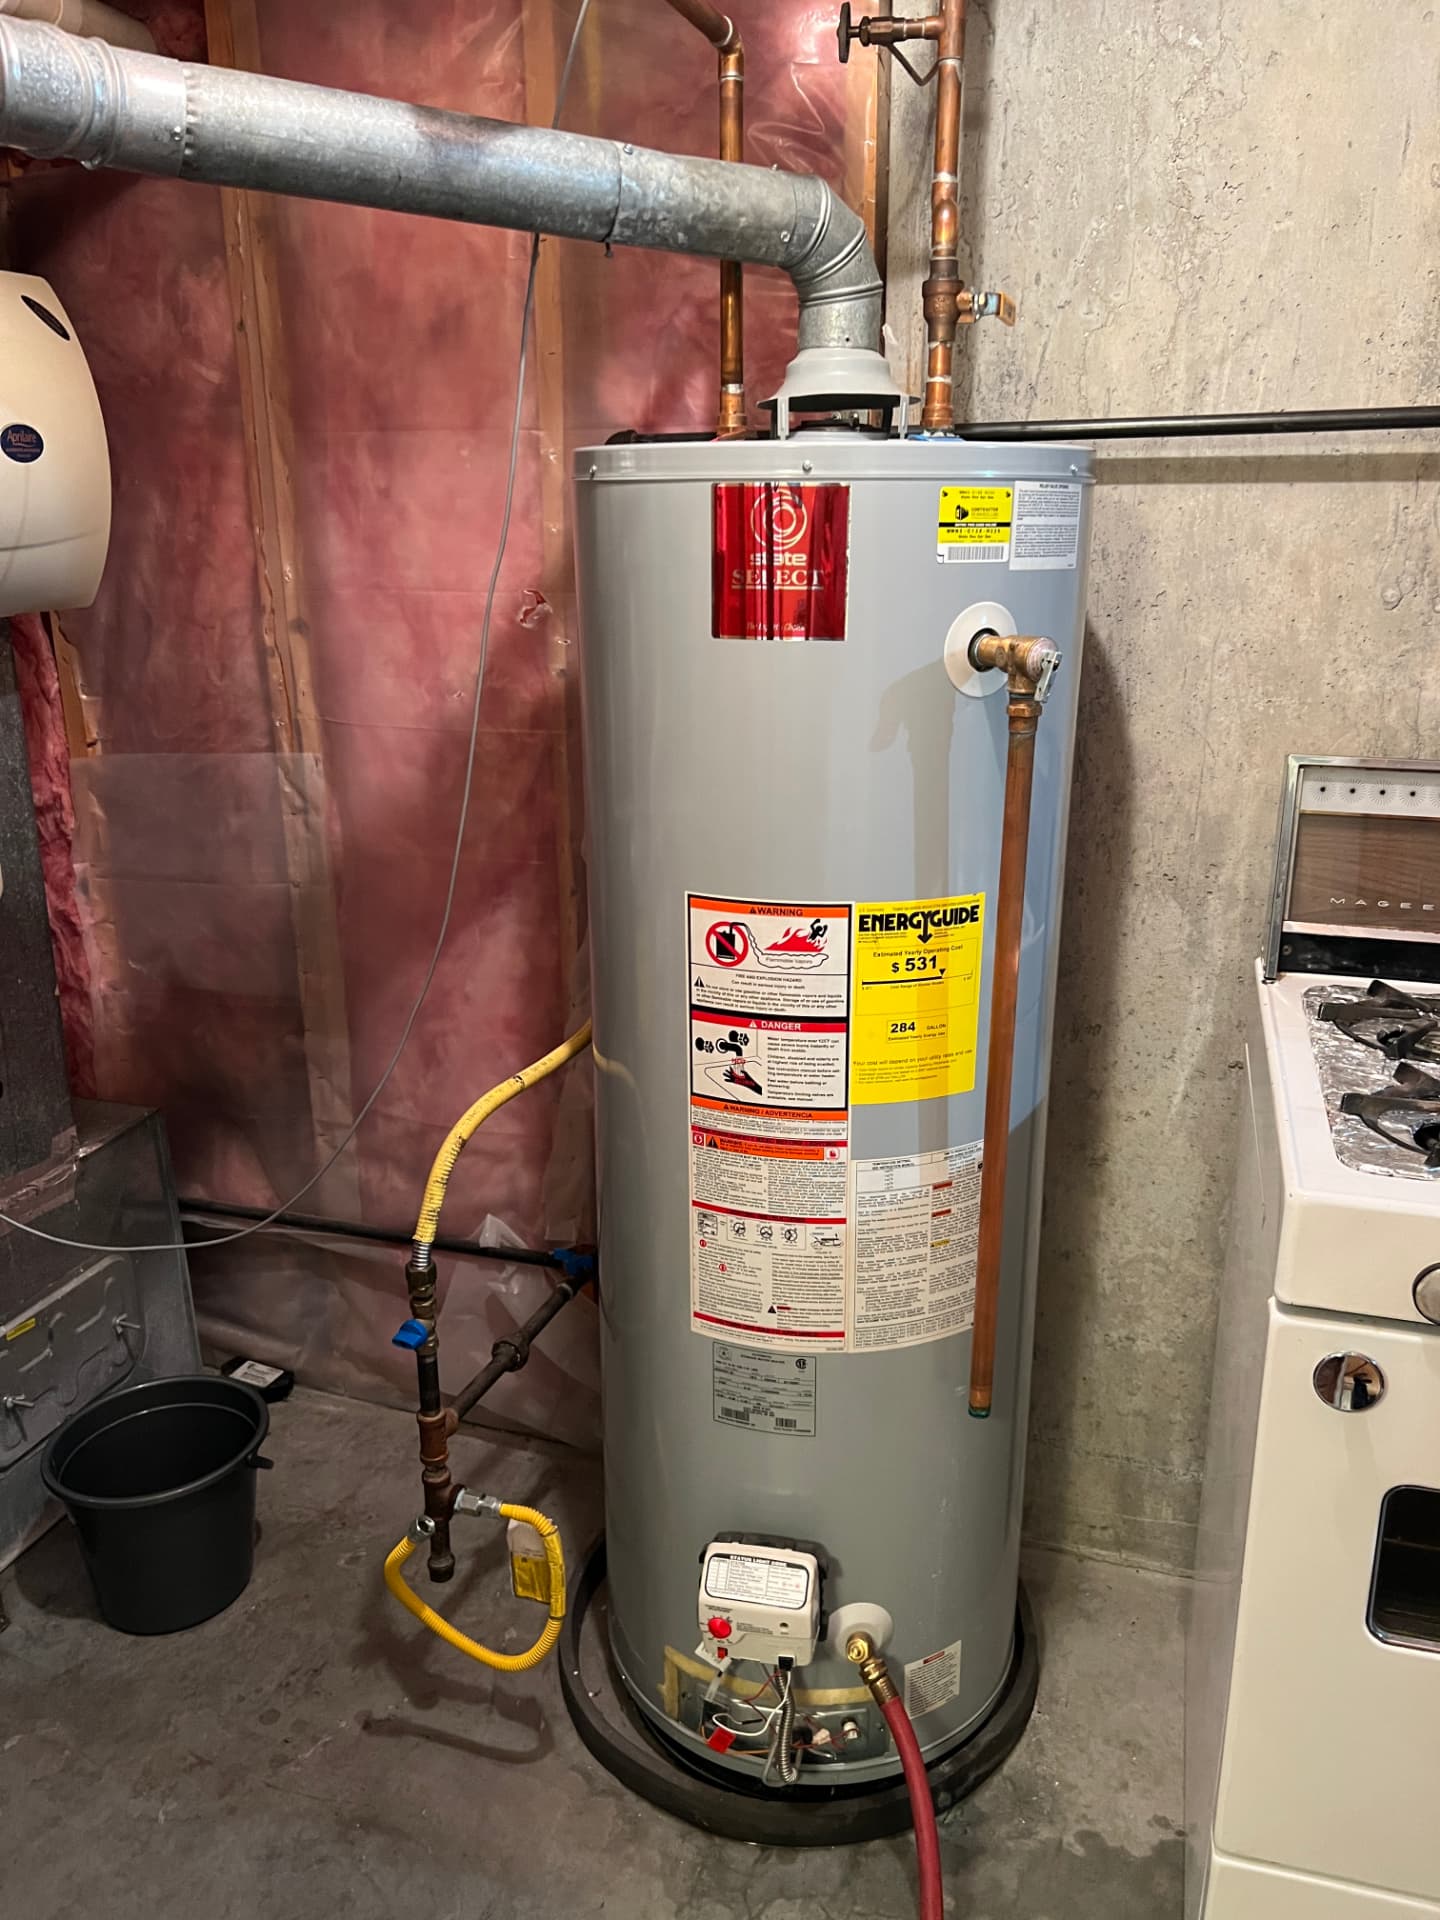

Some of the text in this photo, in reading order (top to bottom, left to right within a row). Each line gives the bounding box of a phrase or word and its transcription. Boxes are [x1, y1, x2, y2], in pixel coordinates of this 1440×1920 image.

[731, 569, 824, 586] SELECT
[758, 907, 803, 917] WARNING
[858, 905, 980, 932] ENERGYGUIDE
[892, 955, 938, 973] $ 531
[761, 1021, 801, 1030] DANGER
[890, 1022, 916, 1033] 284
[730, 1106, 759, 1114] WARNING
[765, 1110, 812, 1118] ADVERTENCIA
